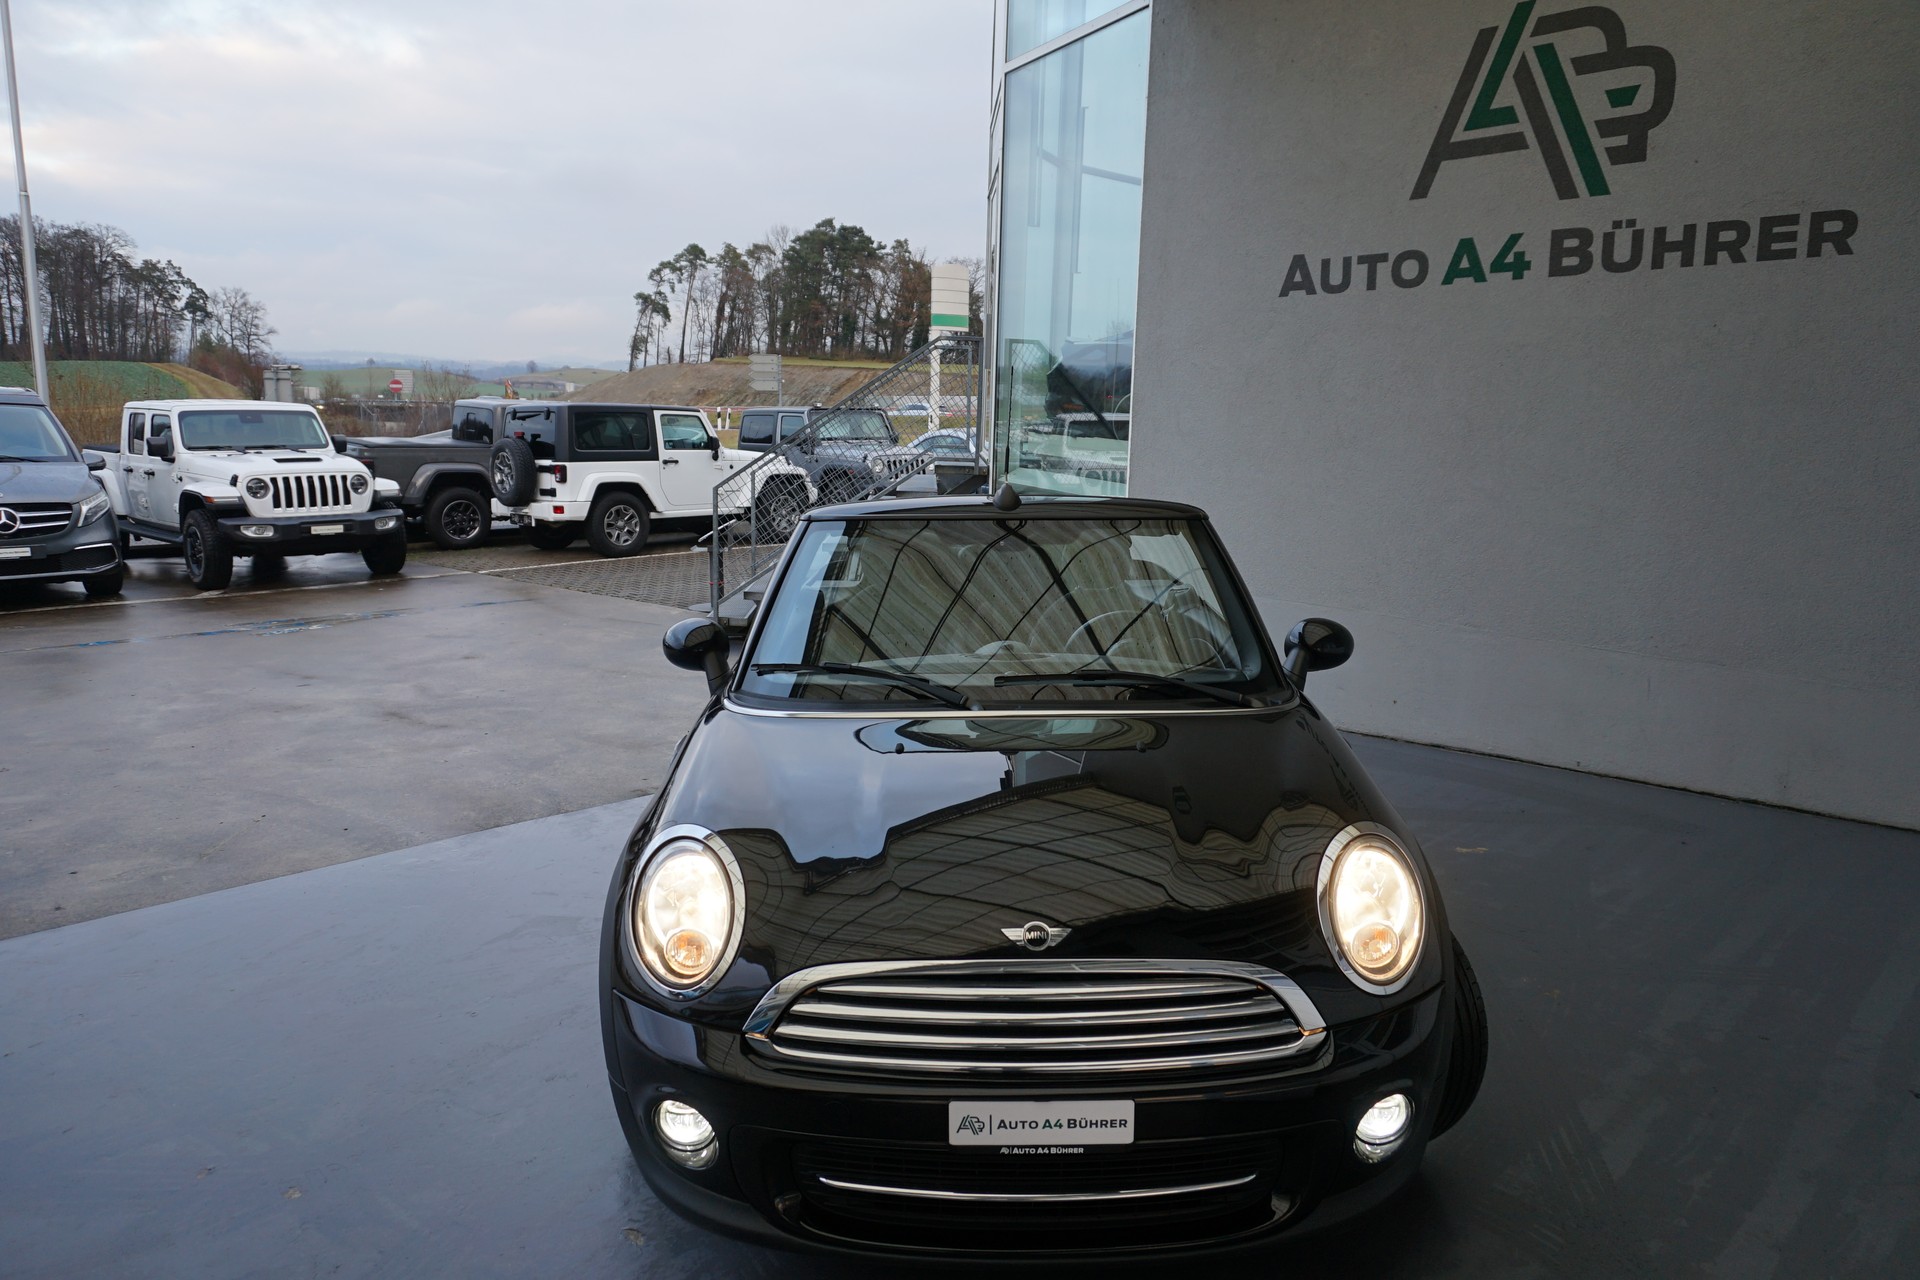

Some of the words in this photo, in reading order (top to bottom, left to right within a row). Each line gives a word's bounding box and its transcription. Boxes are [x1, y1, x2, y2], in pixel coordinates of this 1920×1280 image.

[1278, 249, 1430, 298] AUTO
[1440, 232, 1532, 286] A4
[1547, 208, 1859, 278] BÜHRER
[1026, 930, 1047, 940] MINI
[997, 1118, 1039, 1130] AUTO
[1042, 1118, 1064, 1130] A4
[1066, 1117, 1128, 1129] BÜHRER
[1012, 1147, 1036, 1155] AUTO
